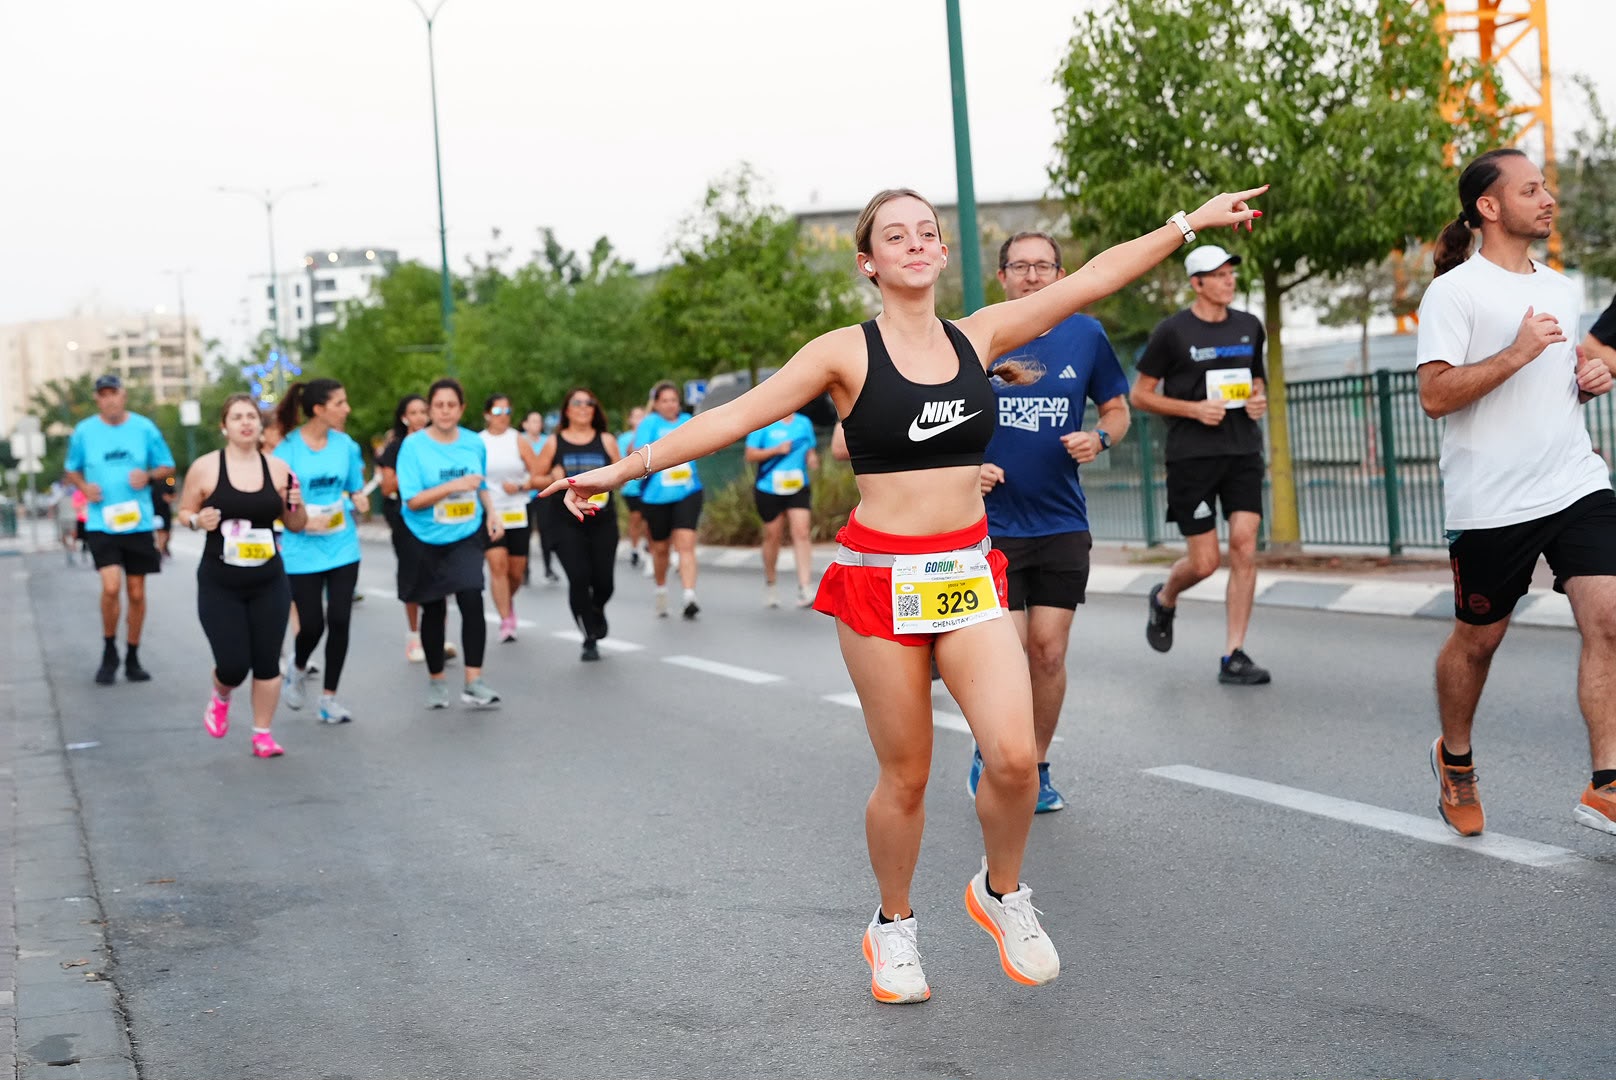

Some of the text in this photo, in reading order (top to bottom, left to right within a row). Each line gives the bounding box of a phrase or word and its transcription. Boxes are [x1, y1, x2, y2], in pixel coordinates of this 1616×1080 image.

[920, 399, 965, 423] NIKE
[999, 397, 1069, 412] מצדיעים
[925, 560, 955, 573] GORUN
[937, 590, 979, 615] 329
